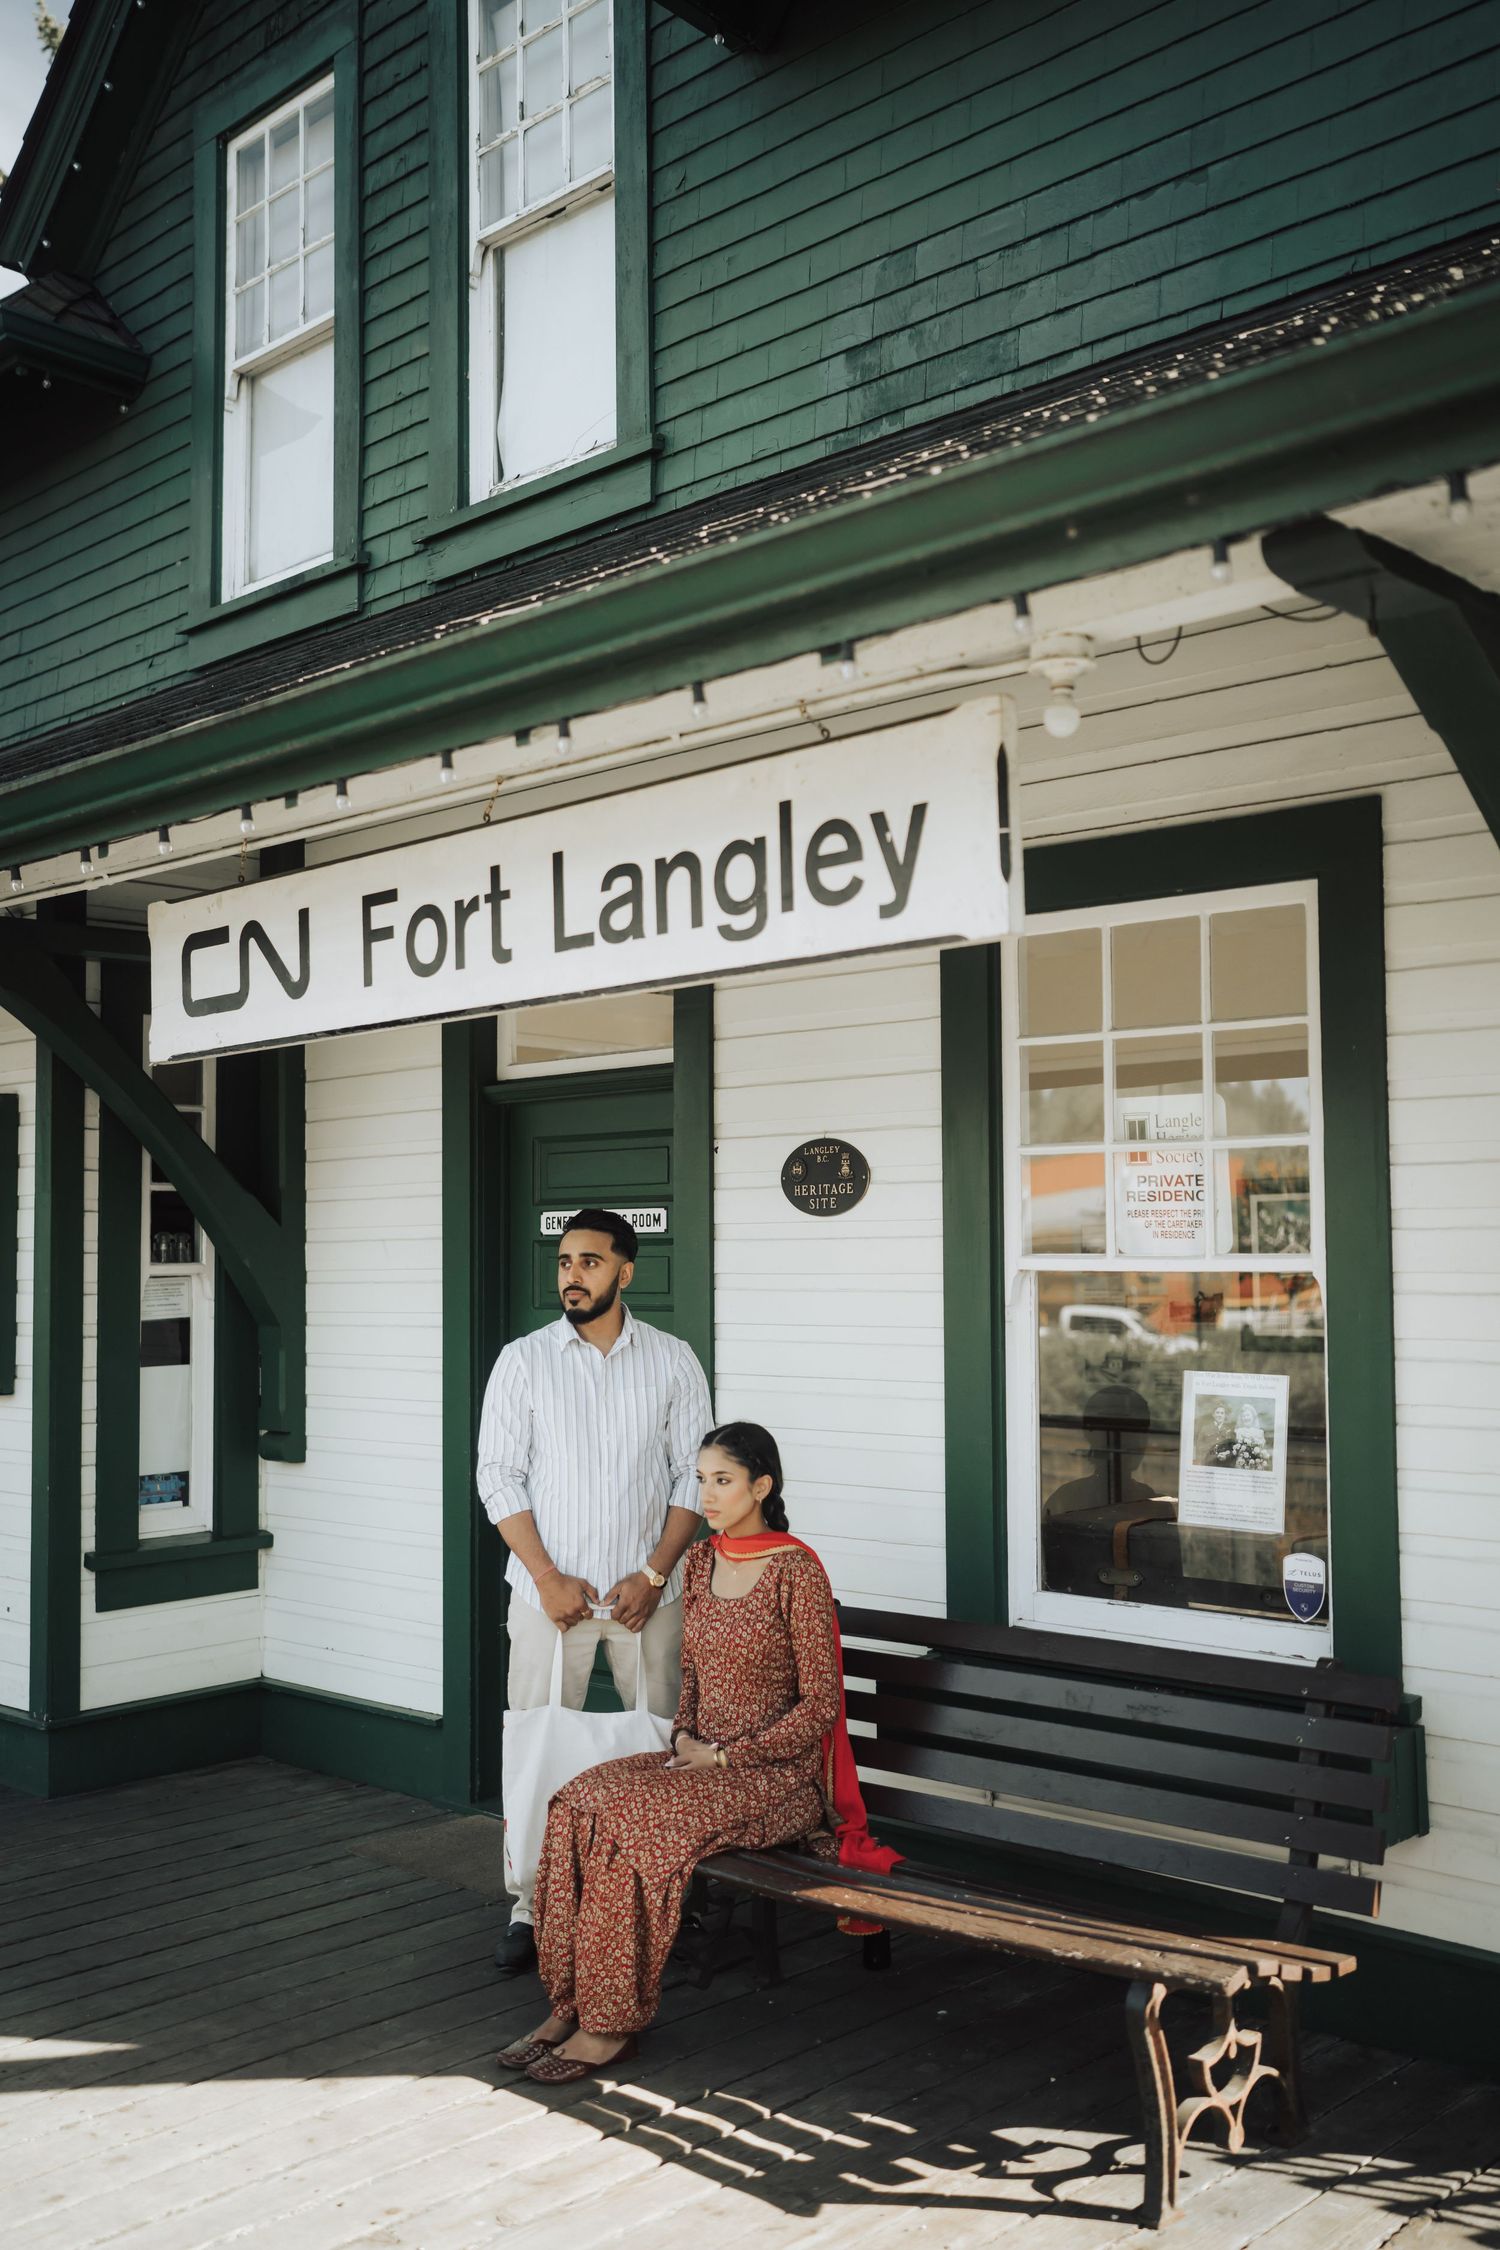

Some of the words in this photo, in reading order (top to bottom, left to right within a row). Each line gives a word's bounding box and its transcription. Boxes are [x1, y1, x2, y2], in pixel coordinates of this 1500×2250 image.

[182, 907, 310, 1019] CN
[361, 864, 512, 988] Fort
[552, 800, 928, 954] Langley
[1155, 1112, 1202, 1131] Langle
[804, 1145, 841, 1155] LANGLEY
[816, 1155, 830, 1163] B.C.
[1156, 1150, 1204, 1166] Society
[1137, 1174, 1204, 1187] PRIVATE
[794, 1183, 854, 1196] HERITAGE
[1126, 1190, 1205, 1202] RESIDENC
[809, 1197, 837, 1210] SITE
[1127, 1209, 1150, 1218] PLEASE
[1150, 1209, 1178, 1218] RESPECT
[1180, 1209, 1192, 1218] THE
[545, 1216, 572, 1230] GENE
[632, 1213, 661, 1228] ROOM
[1144, 1220, 1153, 1229] OF
[1154, 1220, 1166, 1229] THE
[1167, 1220, 1203, 1229] CARETAKER
[1152, 1231, 1159, 1239] IN
[1160, 1231, 1196, 1239] RESIDENCE
[1300, 1570, 1322, 1578] TELUS
